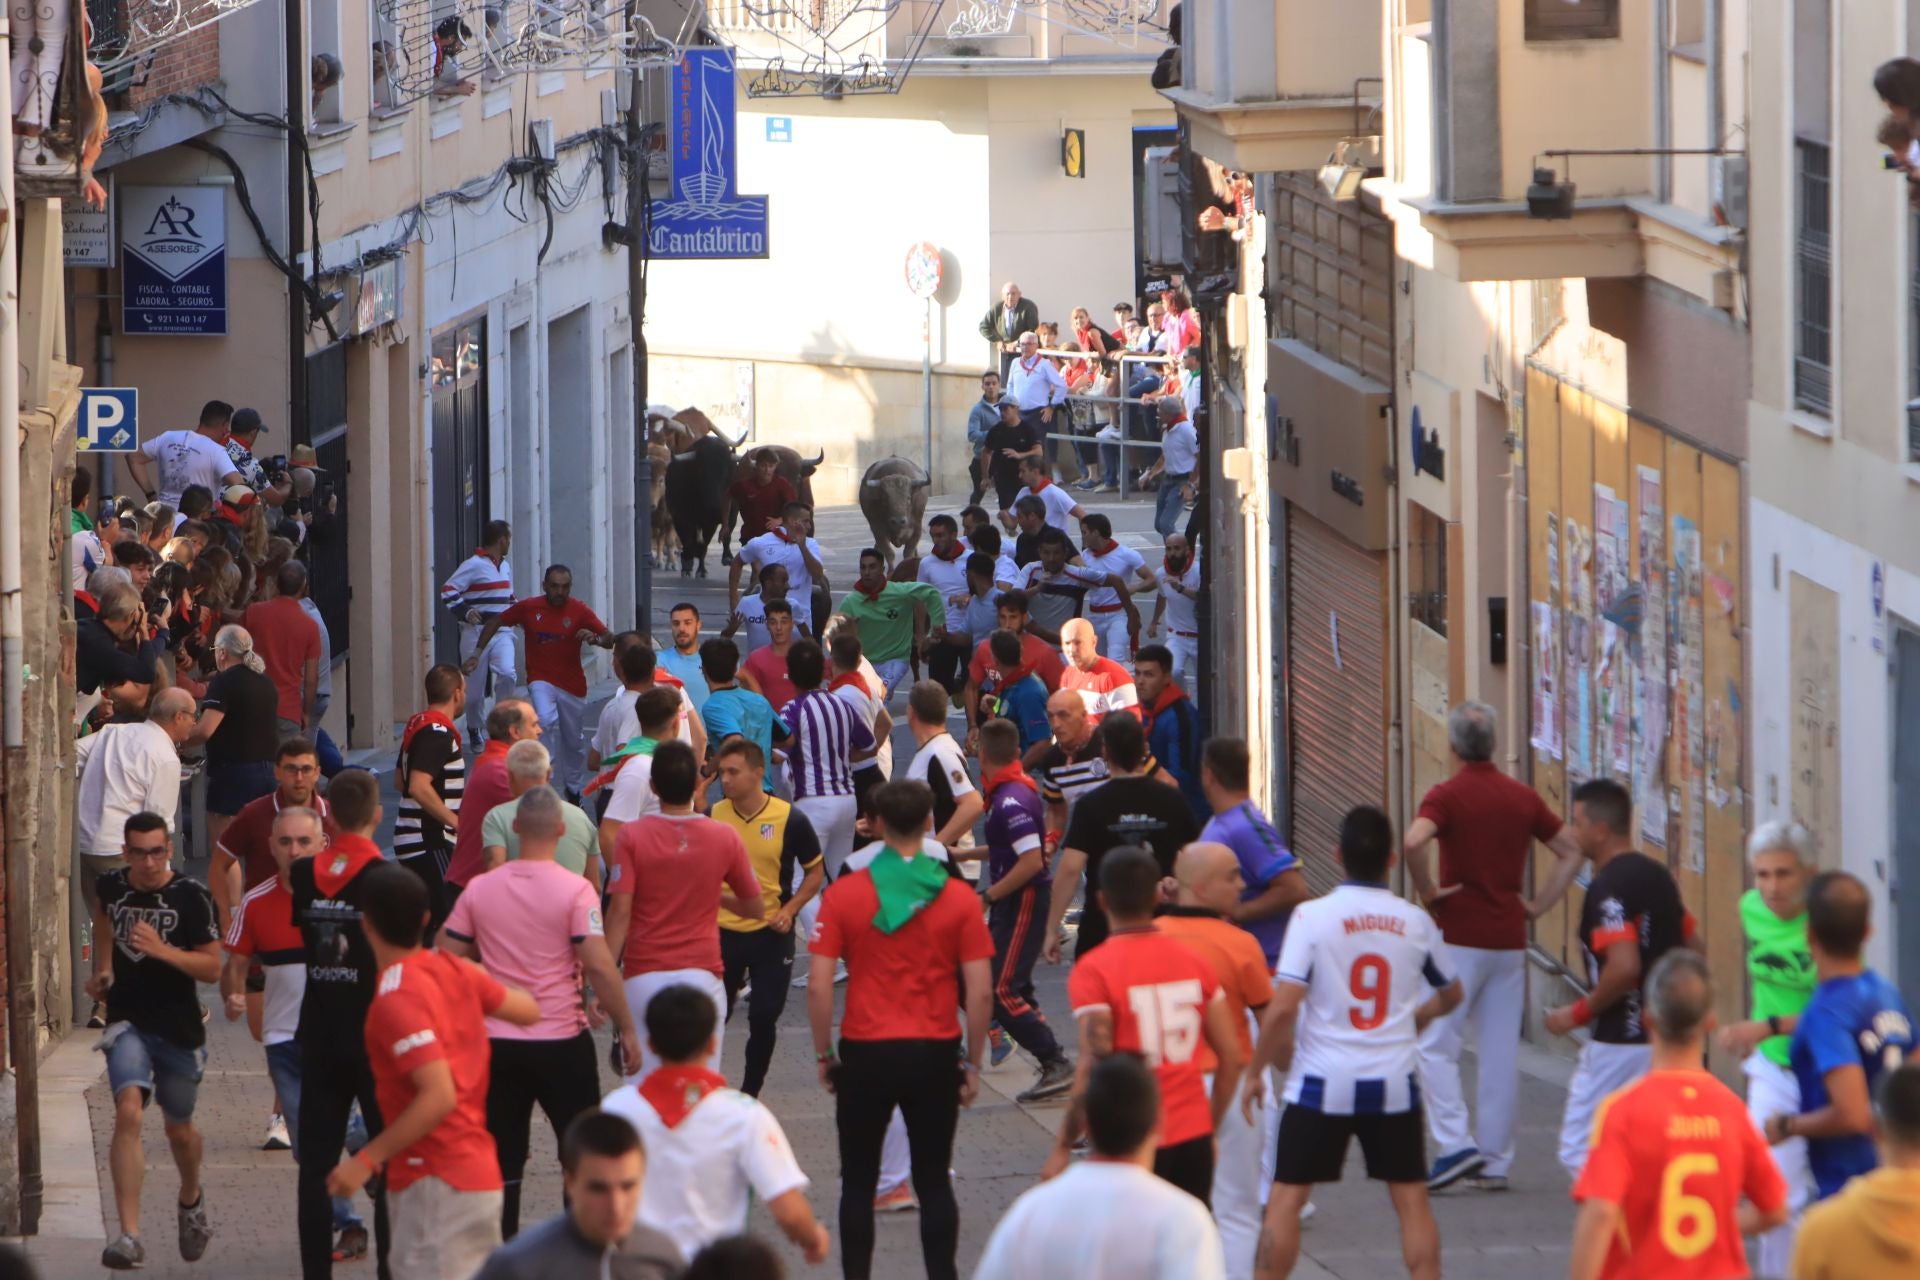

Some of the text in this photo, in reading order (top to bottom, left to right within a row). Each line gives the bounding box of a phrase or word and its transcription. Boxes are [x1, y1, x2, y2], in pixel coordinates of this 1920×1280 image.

[62, 202, 105, 214] Contab
[64, 221, 107, 233] Laboral
[144, 204, 202, 238] AR
[650, 225, 762, 252] Cantábrico
[74, 247, 90, 256] 147
[147, 245, 200, 254] ASESORES
[138, 284, 164, 294] FISCAL
[171, 284, 211, 295] CONTABLE
[136, 296, 170, 306] LABORAL
[177, 297, 214, 306] SEGUROS
[157, 315, 207, 324] 921 140 147
[88, 395, 124, 443] P
[1349, 952, 1391, 1031] 9
[1127, 979, 1202, 1067] 15
[1660, 1153, 1718, 1258] 6
